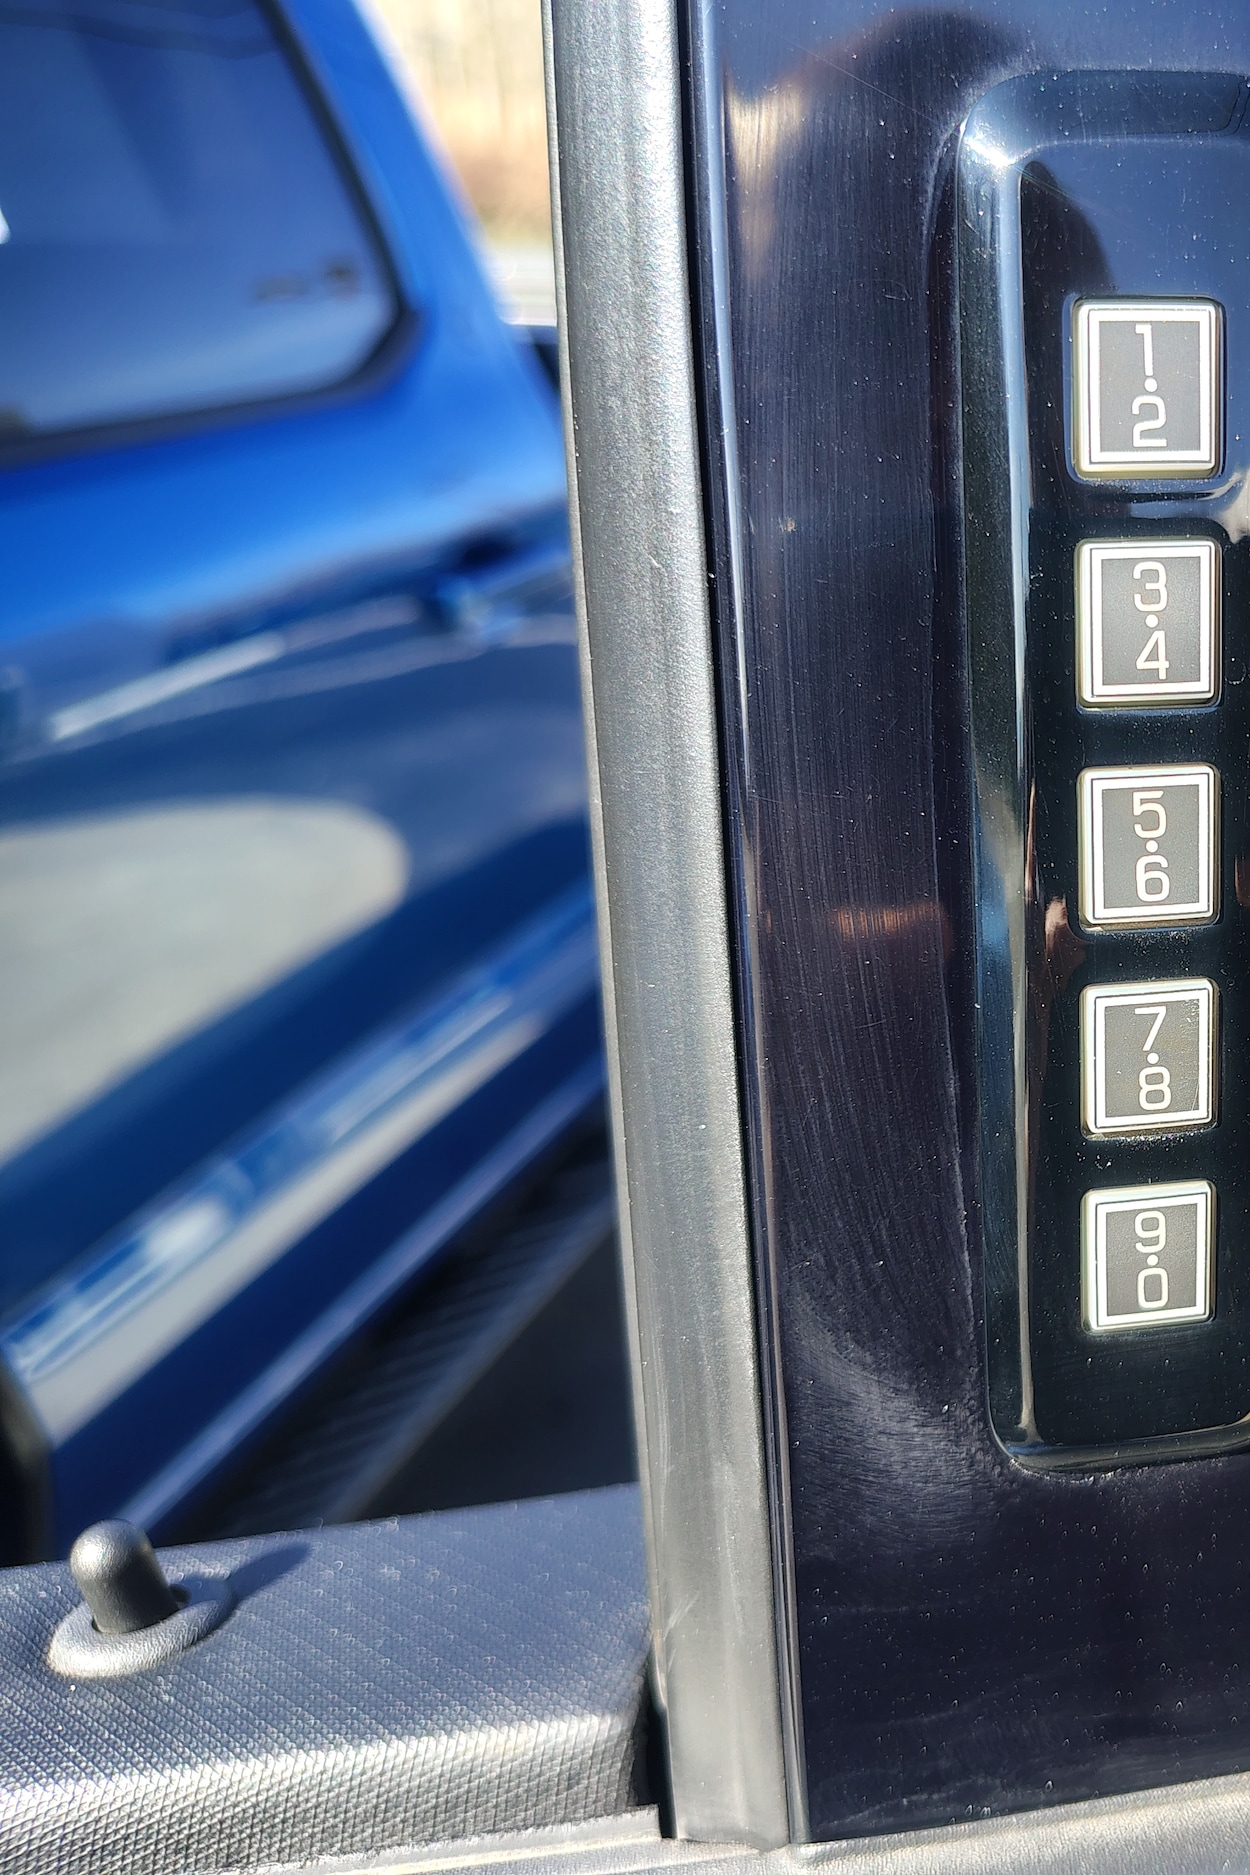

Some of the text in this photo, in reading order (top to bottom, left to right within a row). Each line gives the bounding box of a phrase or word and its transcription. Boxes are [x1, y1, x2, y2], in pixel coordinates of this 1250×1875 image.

[1134, 324, 1154, 376] 1
[1131, 395, 1167, 448] 2
[1133, 562, 1168, 612] 3
[1136, 630, 1170, 680] 4
[1133, 791, 1167, 839] 5
[1136, 854, 1170, 902] 6
[1134, 1005, 1167, 1051] 7
[1138, 1066, 1172, 1111] 8
[1134, 1210, 1166, 1254] 9
[1137, 1267, 1169, 1309] 0
